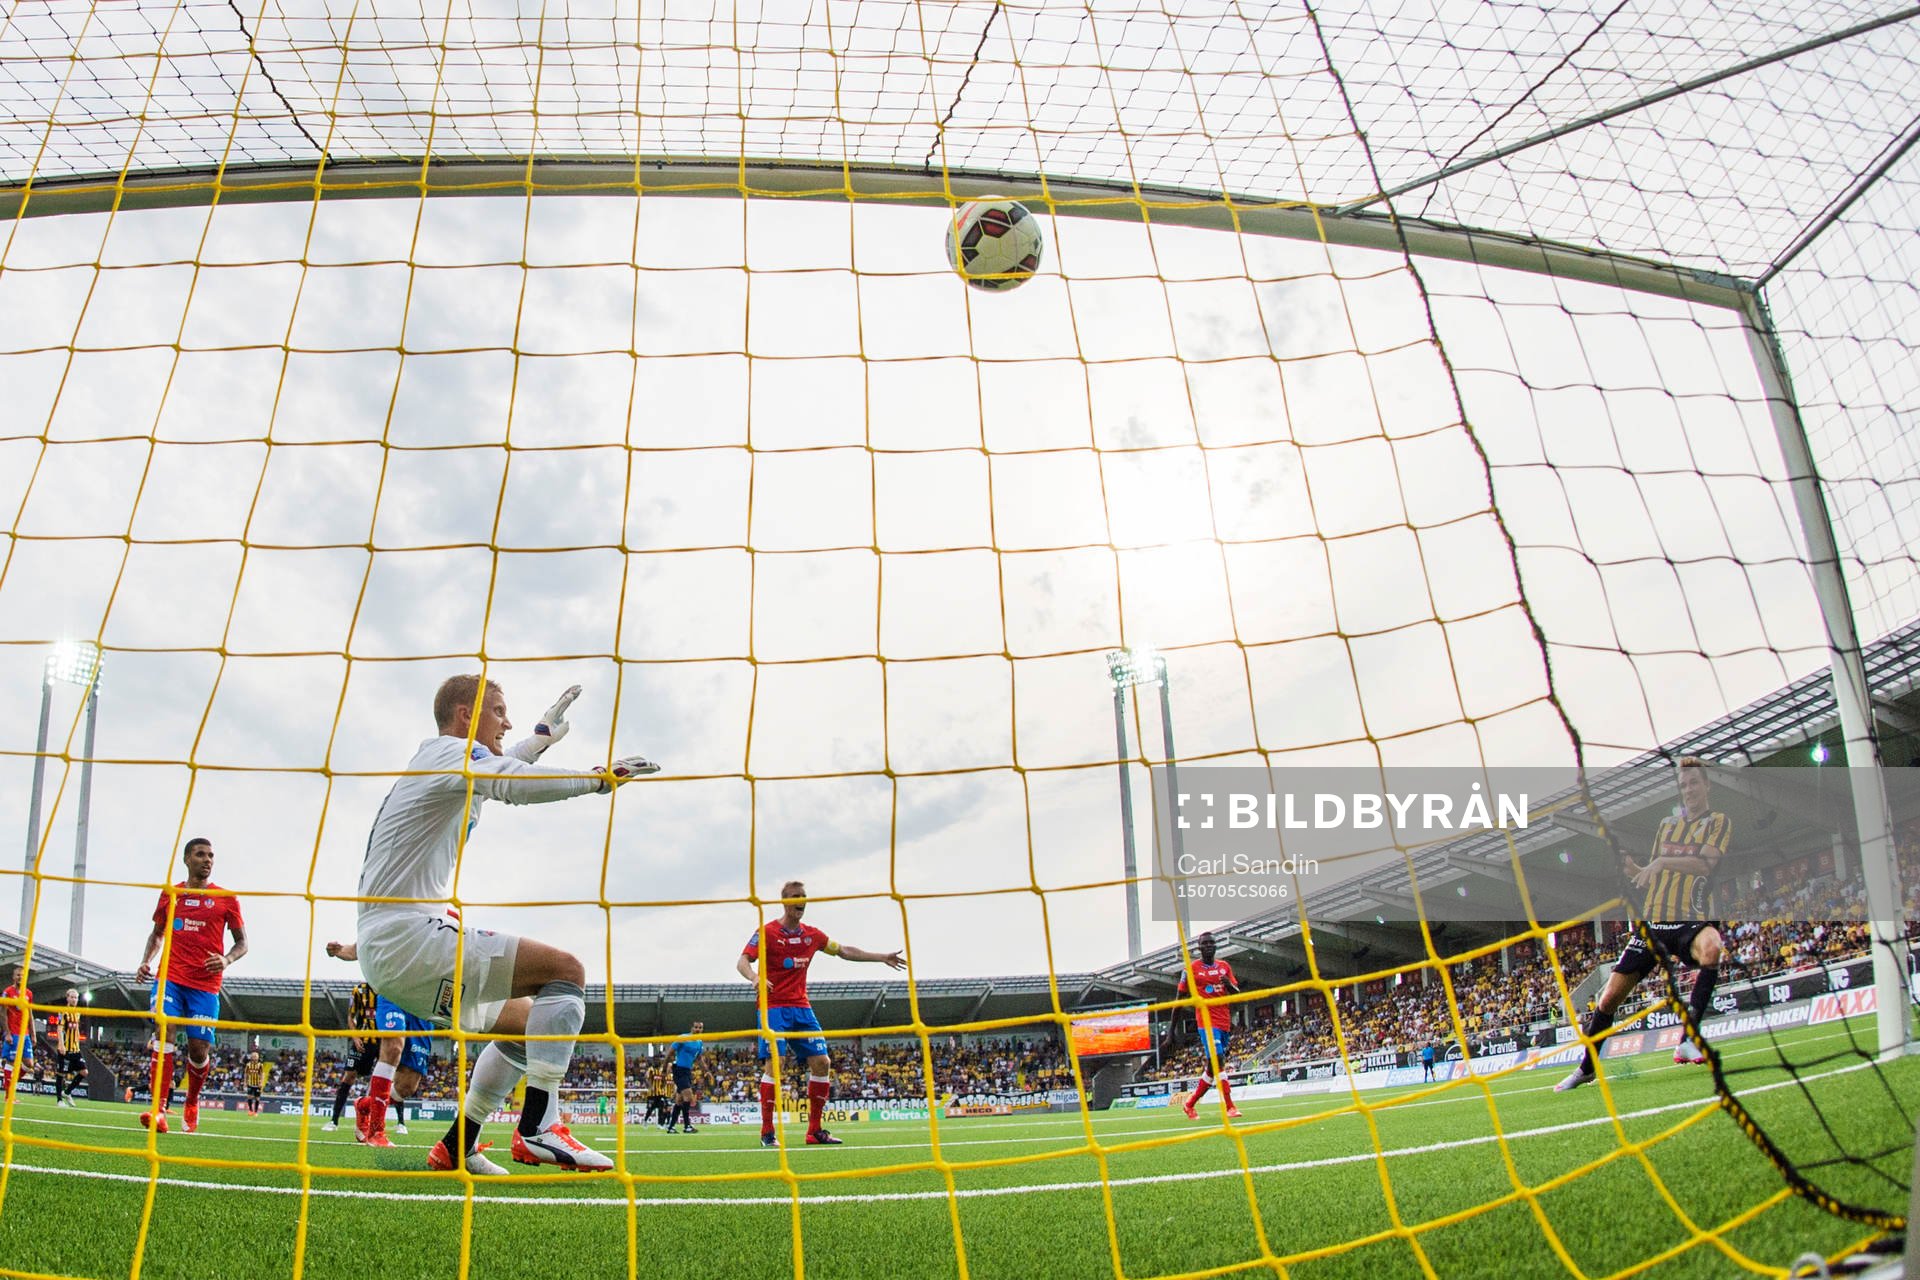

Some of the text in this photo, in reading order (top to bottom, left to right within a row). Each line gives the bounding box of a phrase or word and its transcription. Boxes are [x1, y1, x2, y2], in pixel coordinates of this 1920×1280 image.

[1768, 984, 1792, 1003] isp
[1488, 1038, 1517, 1055] bravida
[1611, 1038, 1641, 1051] BRA
[1368, 1054, 1397, 1067] REKLAM
[280, 1104, 334, 1117] staium
[880, 1110, 931, 1121] Offerta.s
